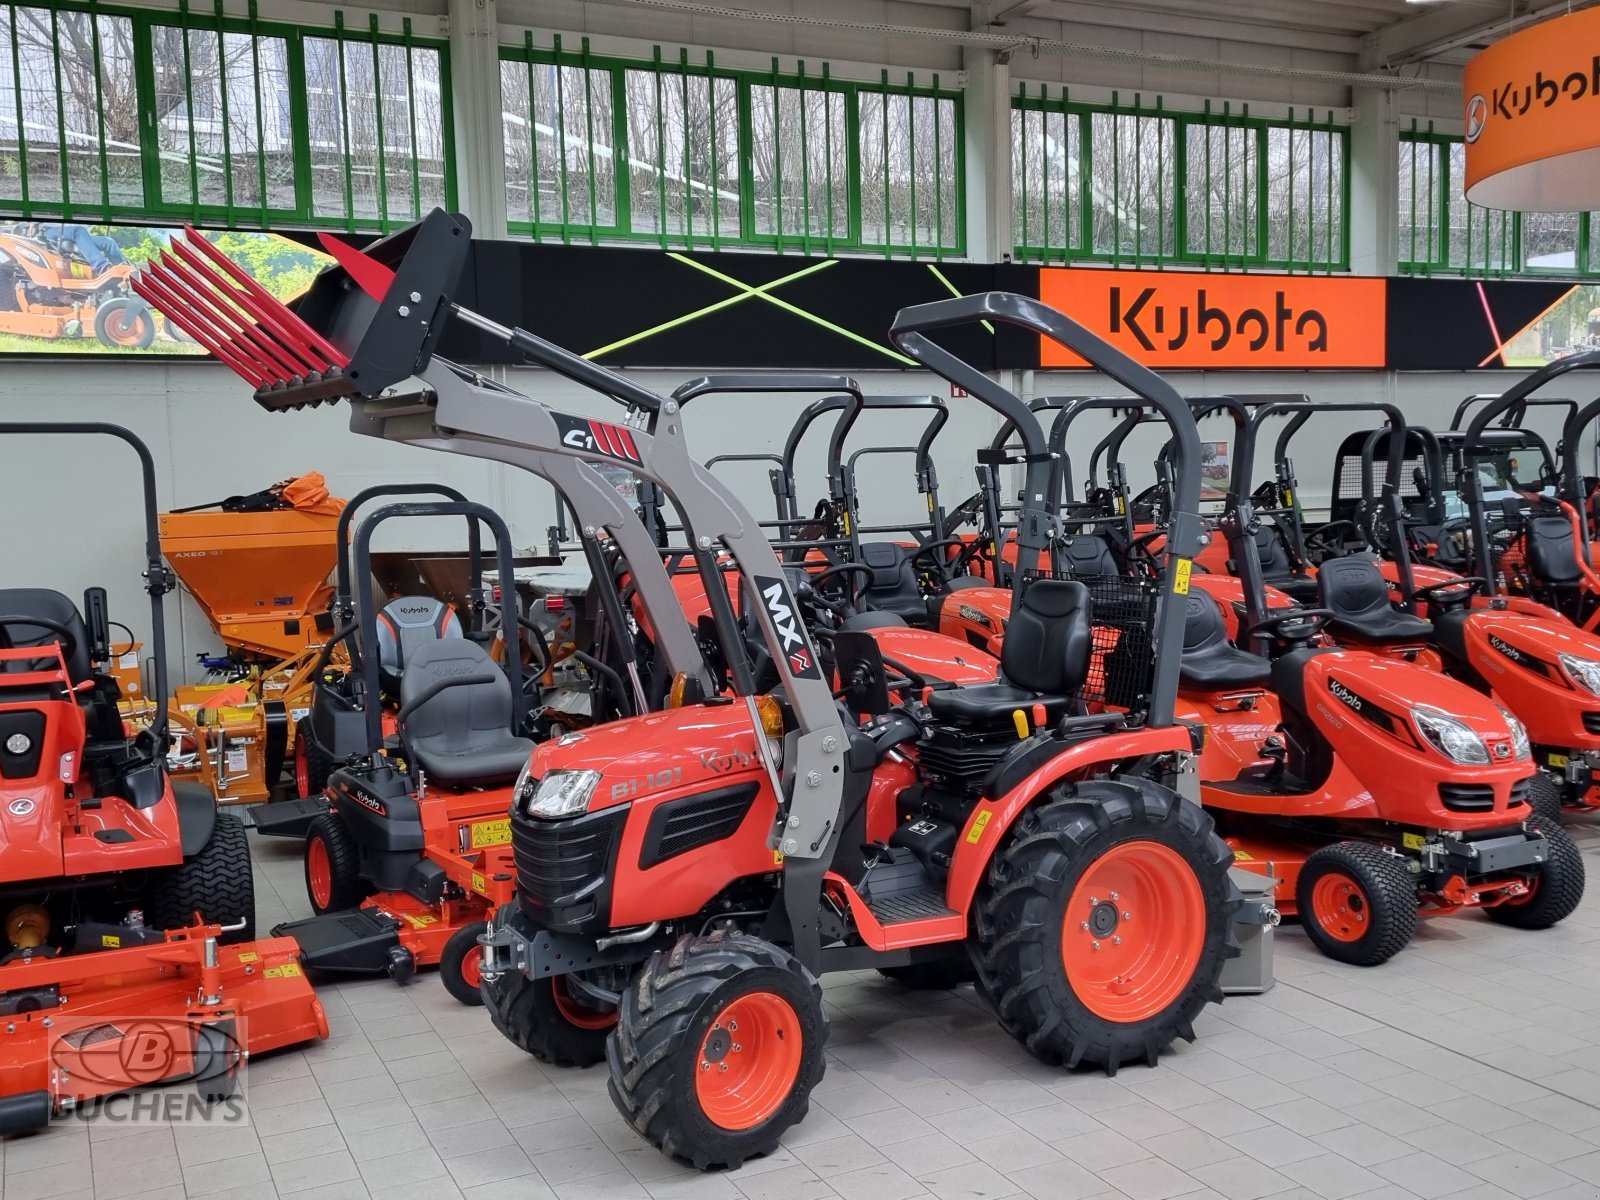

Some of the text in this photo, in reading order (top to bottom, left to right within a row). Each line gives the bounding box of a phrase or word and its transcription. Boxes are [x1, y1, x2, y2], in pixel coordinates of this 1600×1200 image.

[1109, 286, 1328, 352] Kubota
[563, 429, 593, 449] C1
[763, 583, 804, 652] MX
[1490, 636, 1520, 660] Kubota
[1330, 681, 1362, 710] Kubota
[357, 790, 380, 810] Kubota
